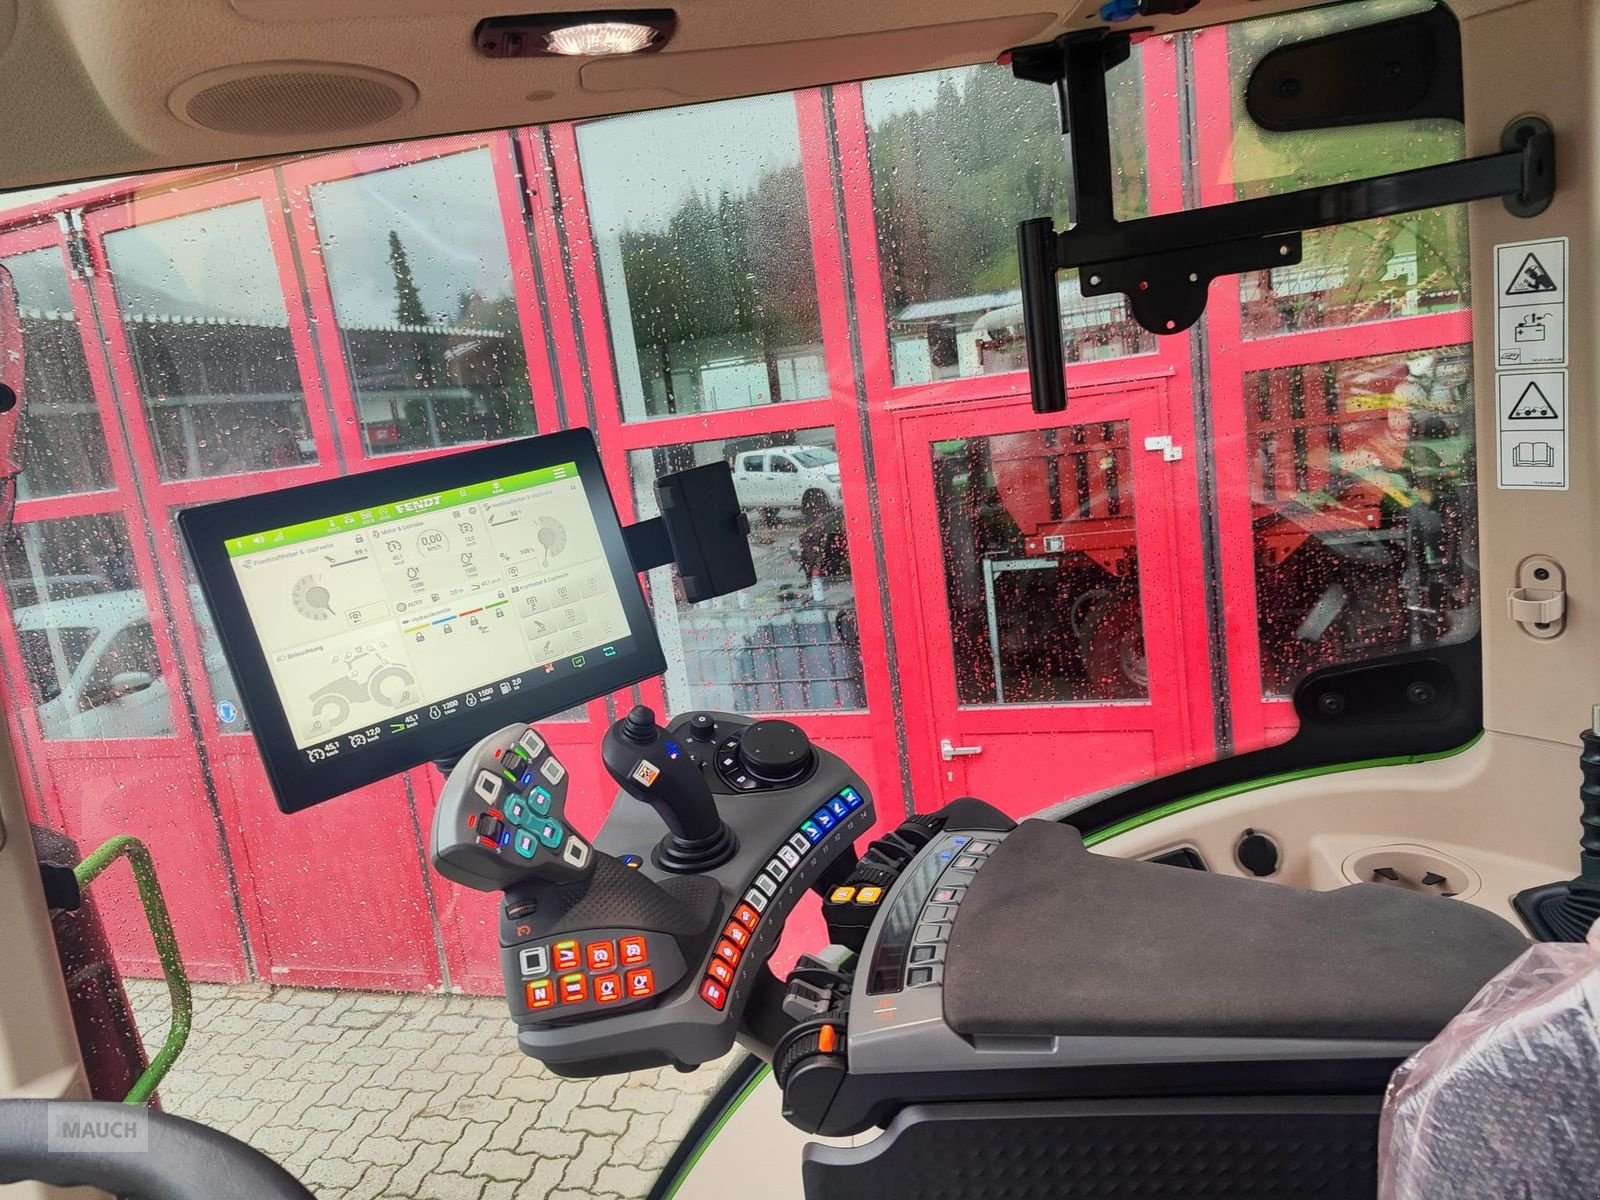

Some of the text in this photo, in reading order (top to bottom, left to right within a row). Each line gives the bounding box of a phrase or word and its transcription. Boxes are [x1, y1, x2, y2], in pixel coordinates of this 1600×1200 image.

[396, 497, 441, 513] FENDT
[421, 533, 442, 546] 0,00
[427, 544, 442, 552] km/h
[408, 599, 422, 608] AUTO
[288, 645, 324, 659] Beleuchtung
[512, 677, 522, 686] 2,0
[478, 687, 494, 698] 1500
[442, 700, 459, 710] 1200
[404, 714, 419, 723] 45,1
[365, 726, 381, 736] 12,0
[324, 741, 340, 752] 45,1
[860, 811, 868, 819] 14
[847, 822, 854, 830] 13
[834, 833, 842, 842] 12
[534, 988, 546, 1000] N
